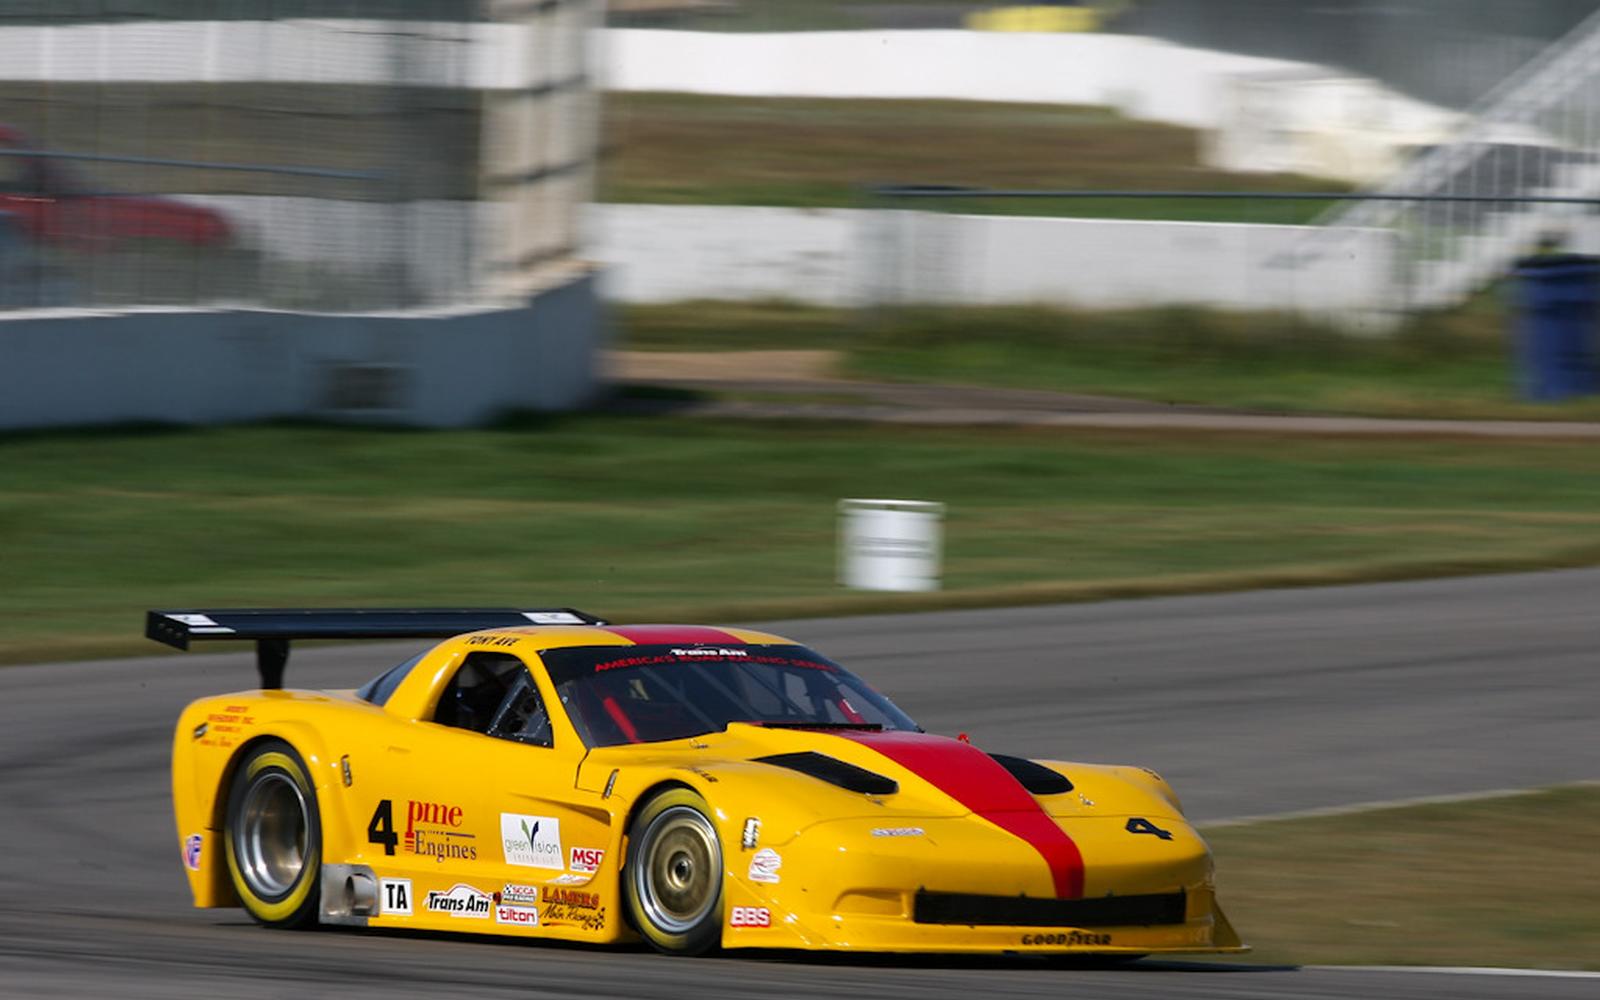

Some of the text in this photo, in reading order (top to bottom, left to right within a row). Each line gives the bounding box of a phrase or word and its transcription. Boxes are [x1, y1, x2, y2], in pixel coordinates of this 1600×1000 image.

[670, 648, 747, 656] Trans Am
[368, 799, 398, 856] 4
[405, 800, 463, 845] pme
[1125, 818, 1174, 841] 4
[415, 829, 477, 863] Engines
[385, 884, 408, 909] TA
[429, 892, 464, 911] Trans
[465, 894, 489, 912] Am
[498, 908, 536, 922] tilton
[731, 907, 770, 927] BBS
[1021, 931, 1112, 946] GOODYEAR
